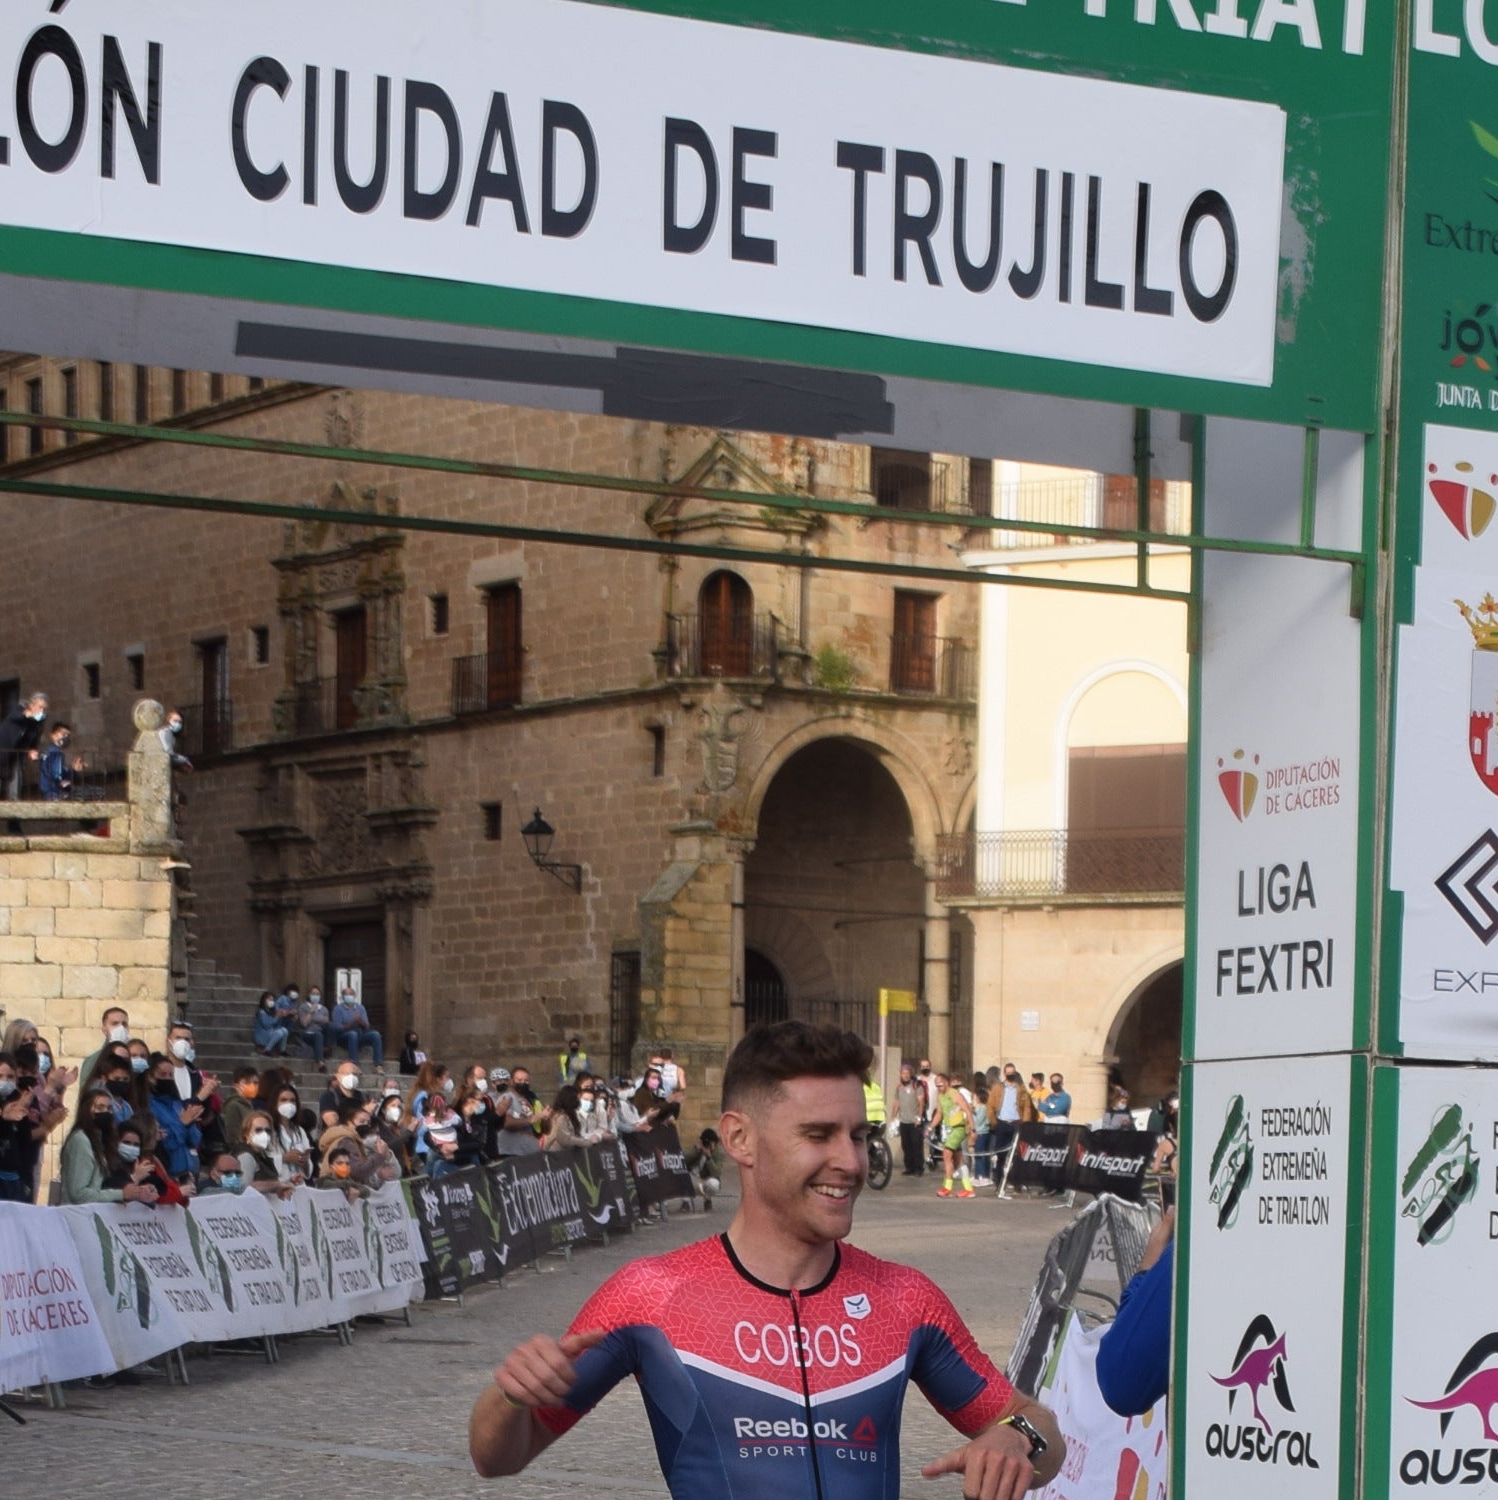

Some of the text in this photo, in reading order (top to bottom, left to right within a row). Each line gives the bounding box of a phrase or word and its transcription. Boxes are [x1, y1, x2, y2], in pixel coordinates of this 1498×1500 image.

[232, 56, 599, 238] CIUDAD
[663, 116, 779, 267] DE
[836, 141, 1239, 324] TRUJILLO
[1436, 382, 1482, 411] JUNTA
[1266, 755, 1341, 791] DIPUTACIÓN
[1266, 785, 1341, 816] DE CÁCERES
[1238, 861, 1317, 917] LIGA
[1216, 938, 1334, 997] FEXTRI
[1261, 1100, 1332, 1137] FEDERACIÓN
[1262, 1147, 1328, 1181] EXTREMEÑA
[1258, 1196, 1273, 1225] DE
[1, 1264, 78, 1300] DIPUTACIÓN
[7, 1299, 90, 1337] DE CÁCERES
[733, 1321, 863, 1367] COBOS
[733, 1416, 848, 1441] Reebok
[1205, 1423, 1320, 1469] austral
[739, 1446, 878, 1462] SPORT CLUB
